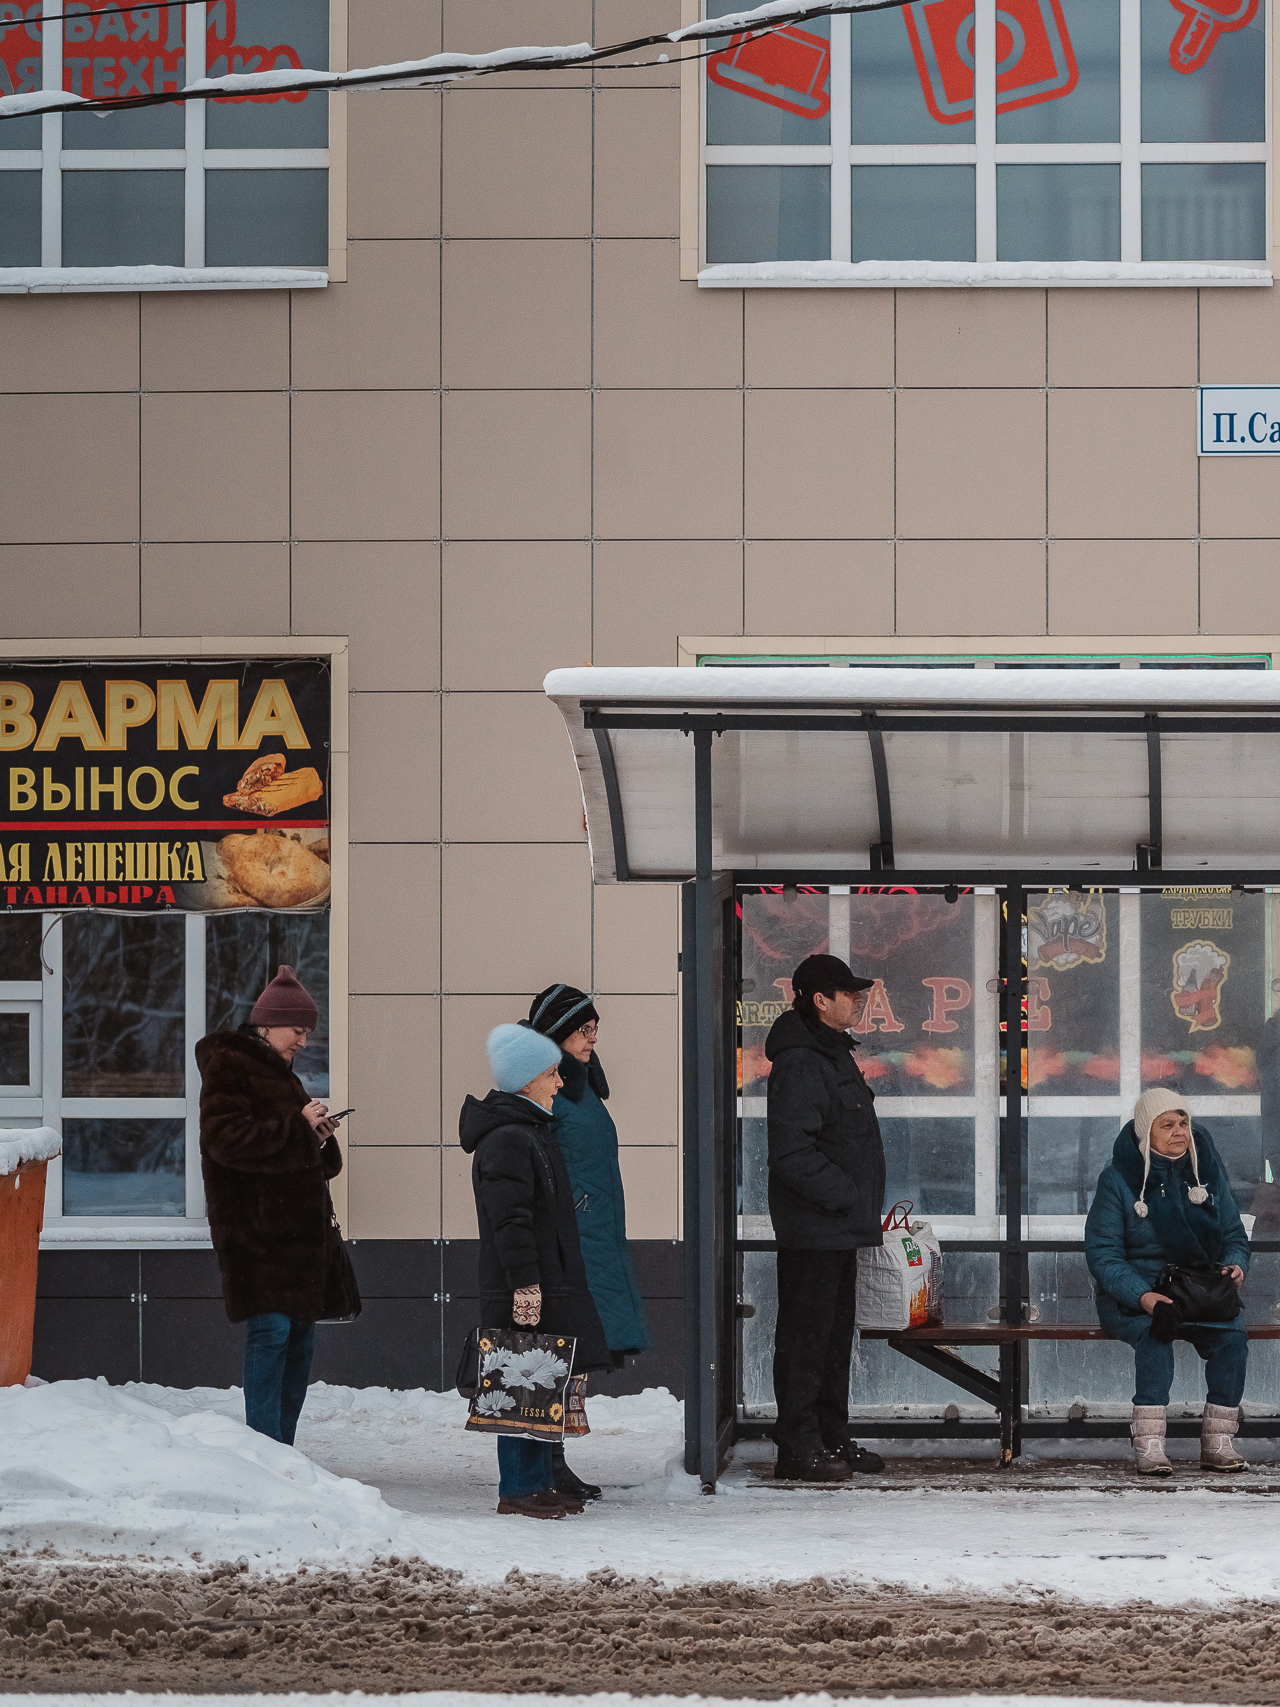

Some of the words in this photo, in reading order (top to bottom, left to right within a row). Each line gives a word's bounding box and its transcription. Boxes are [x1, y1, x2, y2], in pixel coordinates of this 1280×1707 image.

[0, 678, 311, 751] ВАРМА
[9, 766, 200, 811] ВЫНОС
[42, 841, 205, 882] ЛЕПЕШКА
[3, 885, 177, 906] ТАНДЫРА
[1171, 908, 1234, 929] ТРУБКИ
[520, 1406, 545, 1418] TESSA
